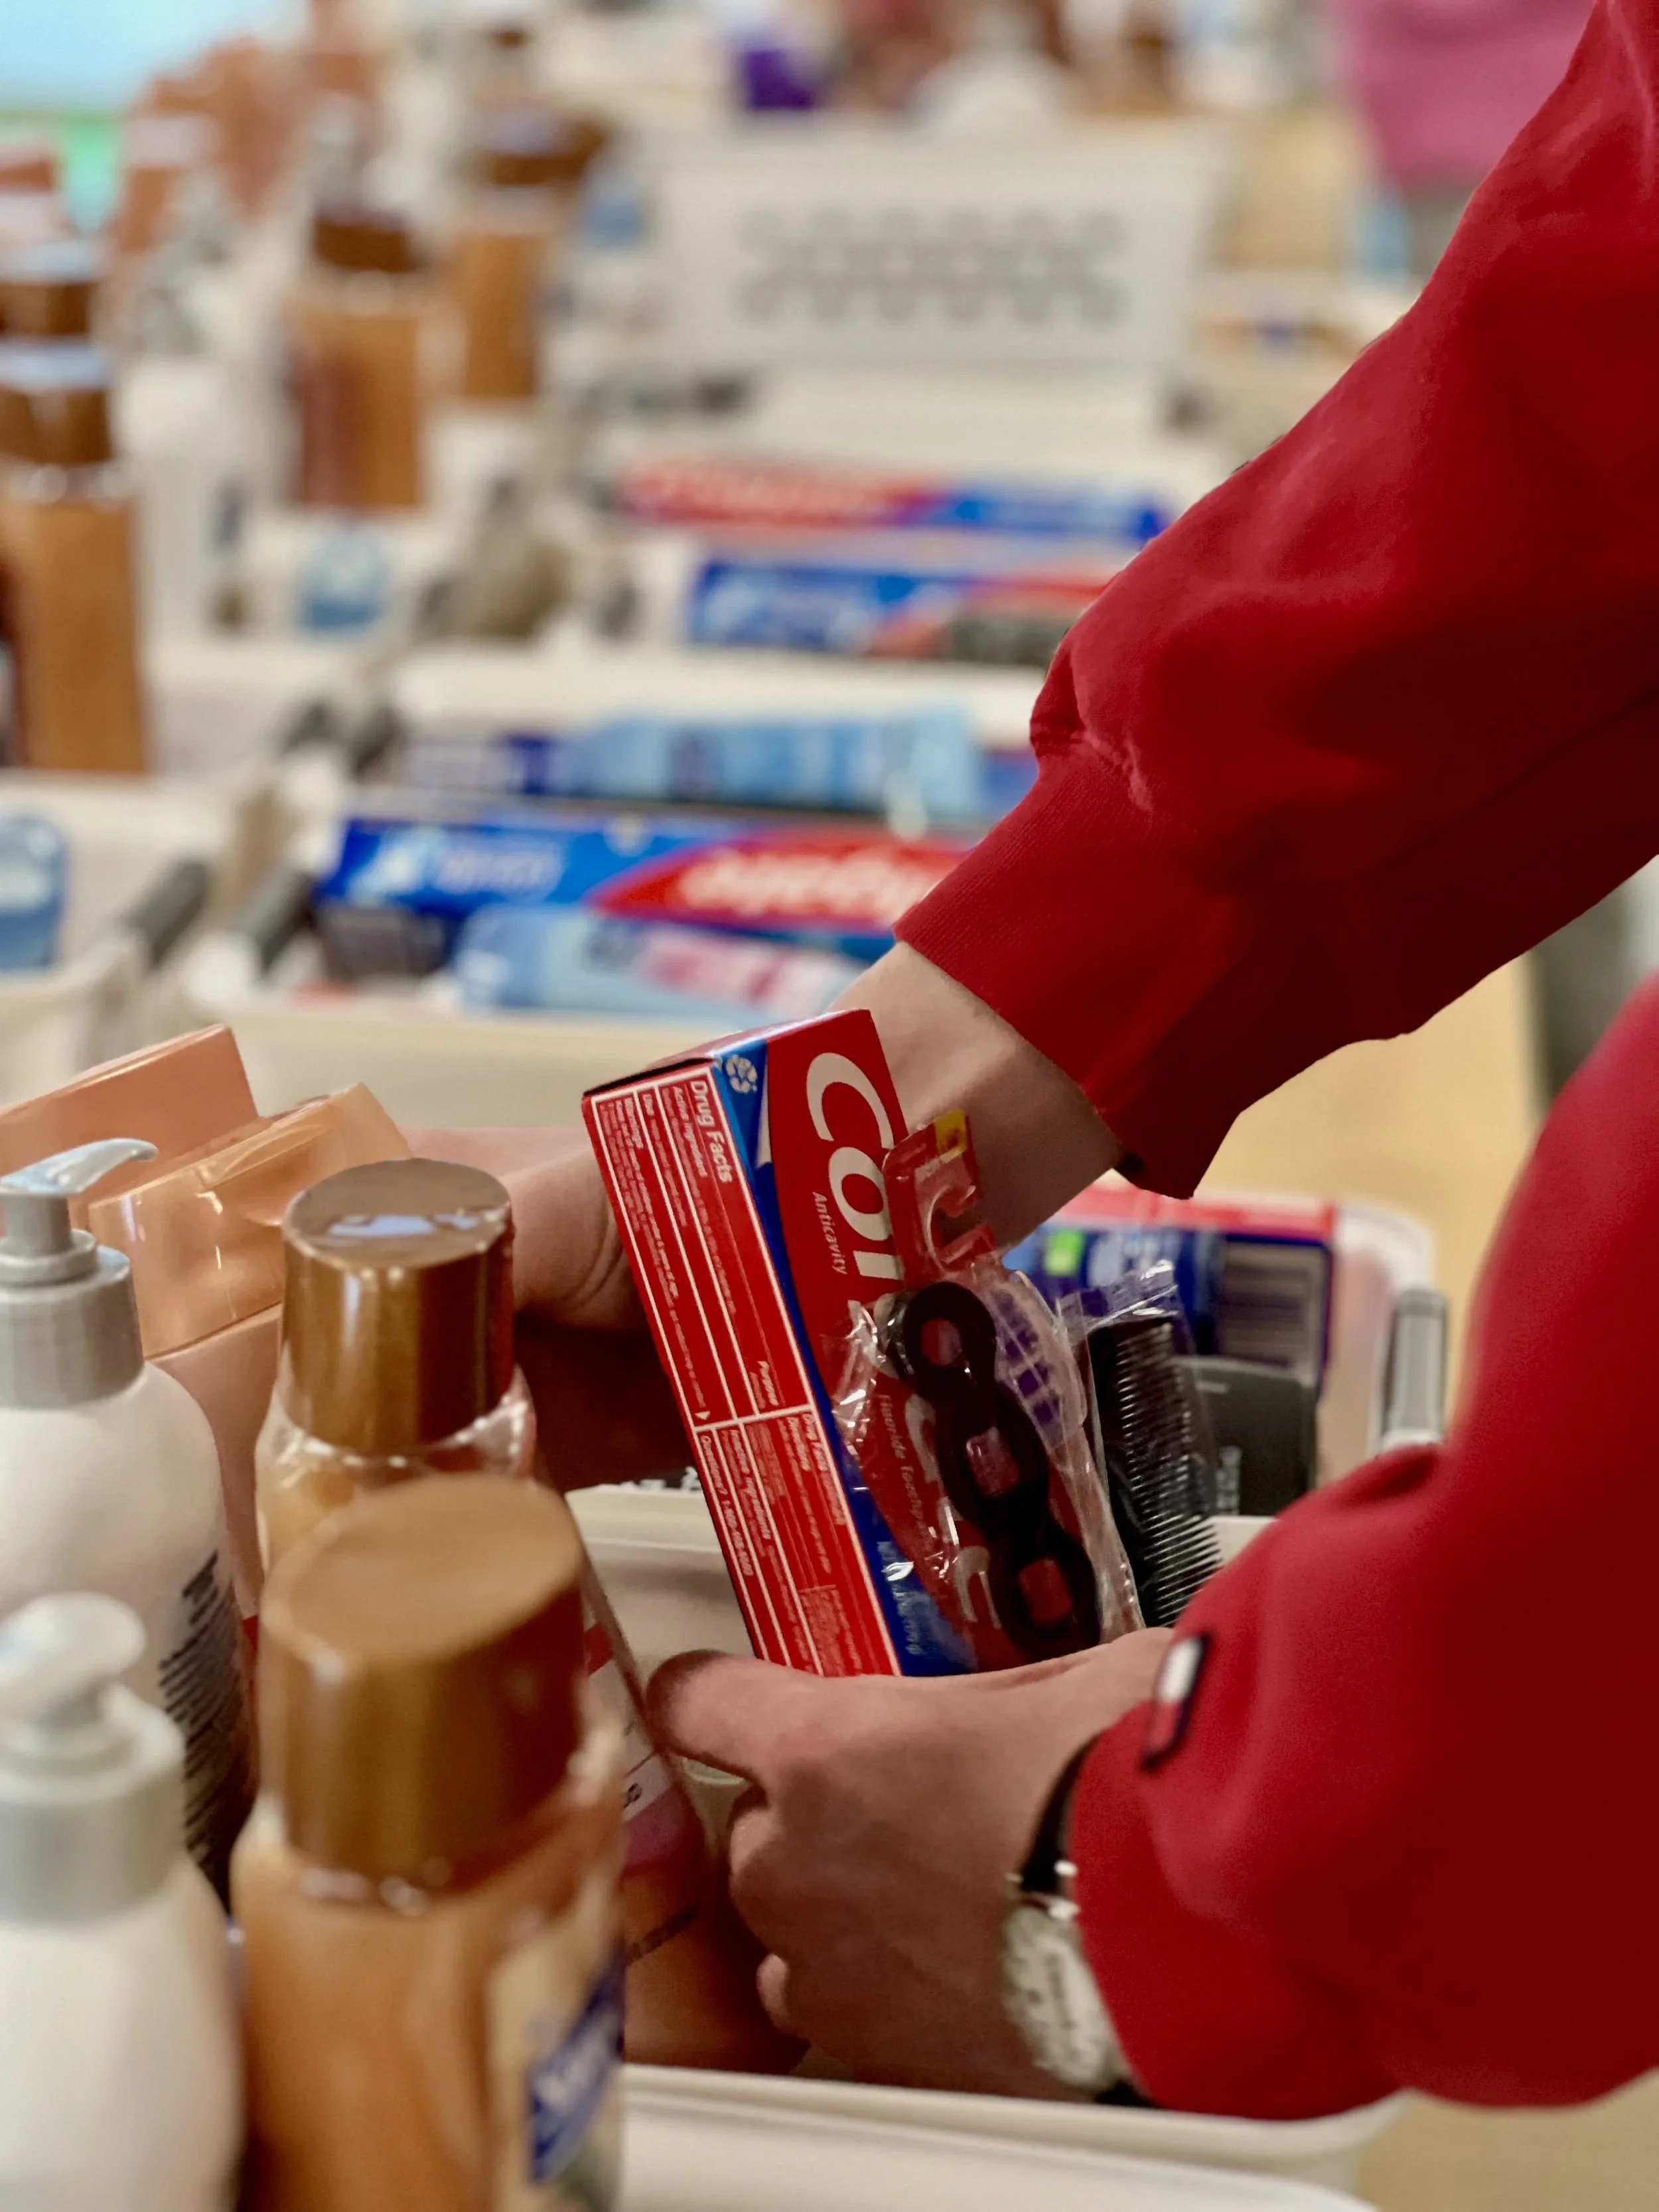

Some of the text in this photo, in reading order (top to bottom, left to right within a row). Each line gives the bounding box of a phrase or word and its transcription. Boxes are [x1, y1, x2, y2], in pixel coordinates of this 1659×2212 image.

[691, 1080, 733, 1183] Drug Facts
[812, 1191, 848, 1275] Anticavity
[879, 1394, 906, 1459] Fluoride
